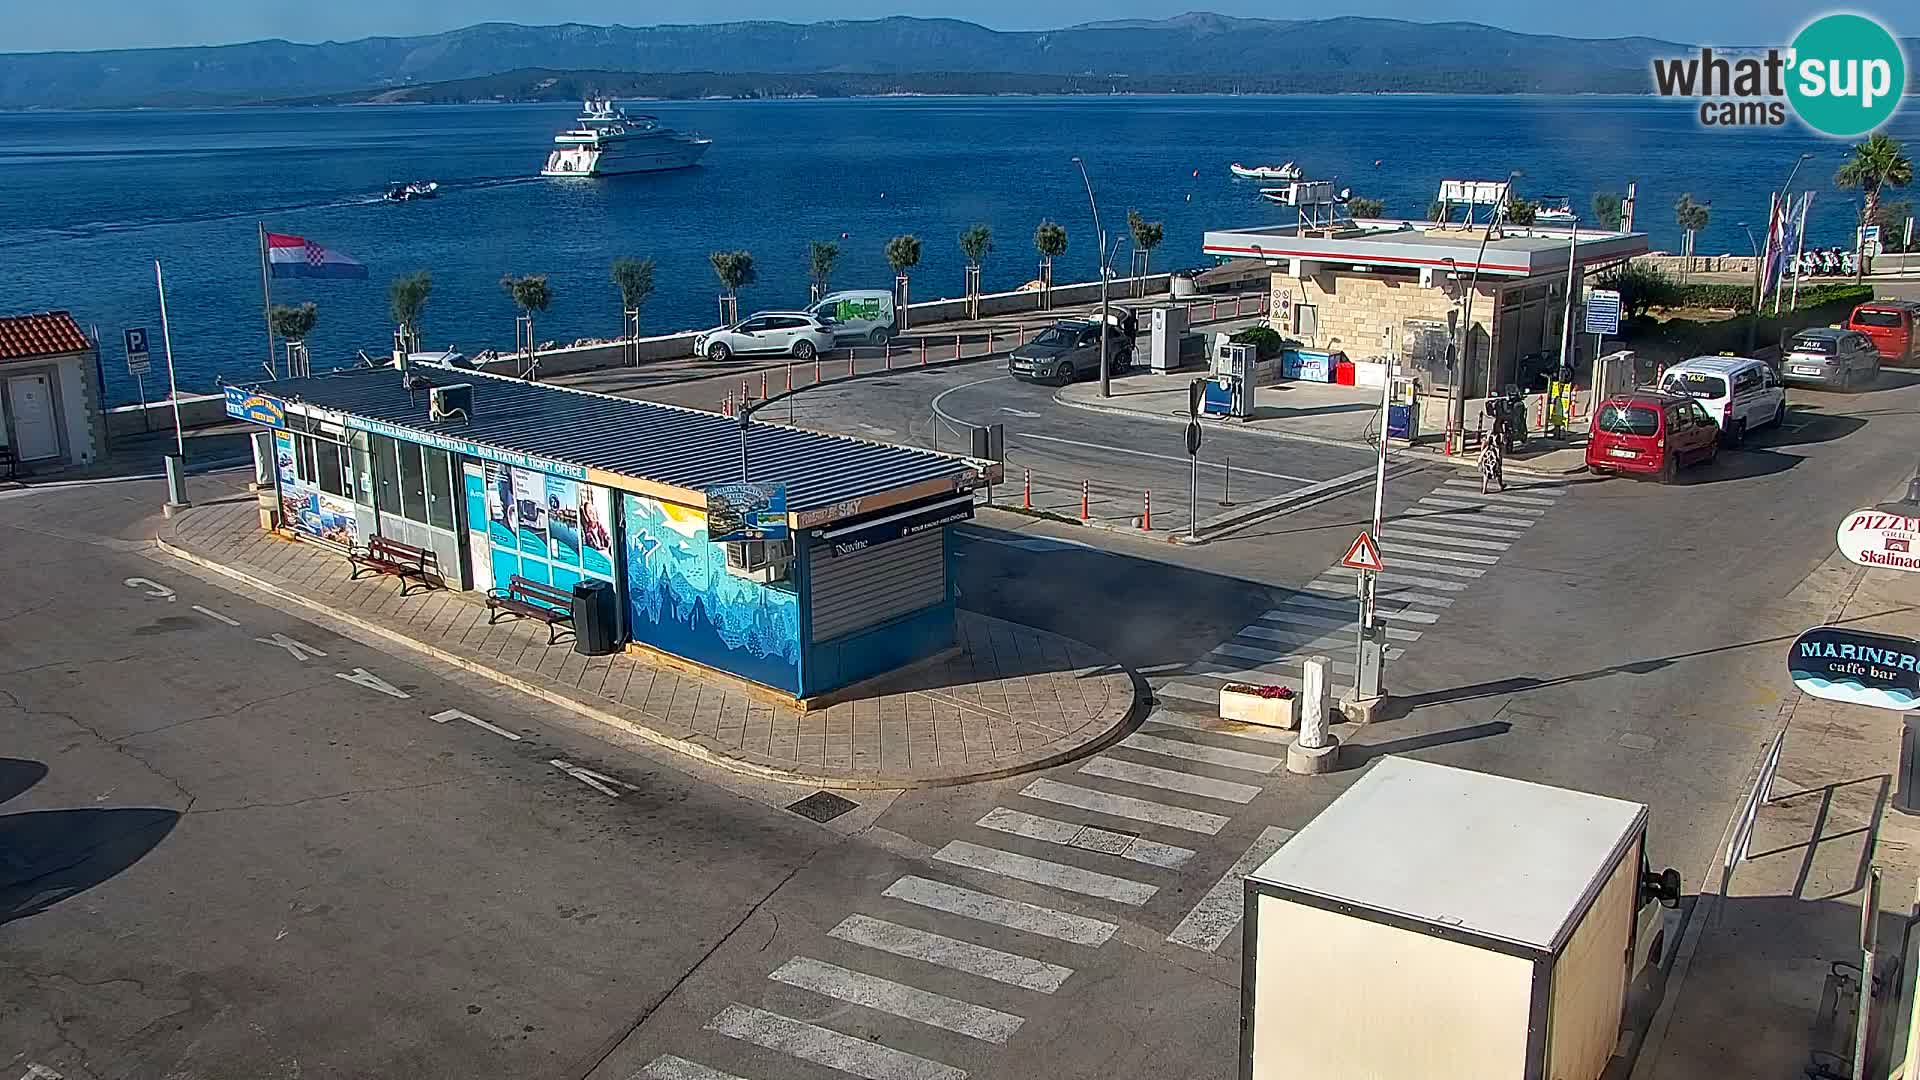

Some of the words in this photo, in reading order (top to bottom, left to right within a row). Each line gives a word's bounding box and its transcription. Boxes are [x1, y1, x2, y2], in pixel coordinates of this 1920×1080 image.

[130, 332, 142, 350] P
[1687, 374, 1705, 382] TAXI
[436, 437, 467, 453] POSTAJA
[478, 446, 493, 458] BUS
[493, 449, 526, 465] STATION
[527, 456, 555, 472] TICKET
[555, 462, 583, 478] OFFICE
[1881, 530, 1917, 541] GRILL
[1829, 662, 1866, 676] caffe
[1870, 665, 1897, 680] bar
